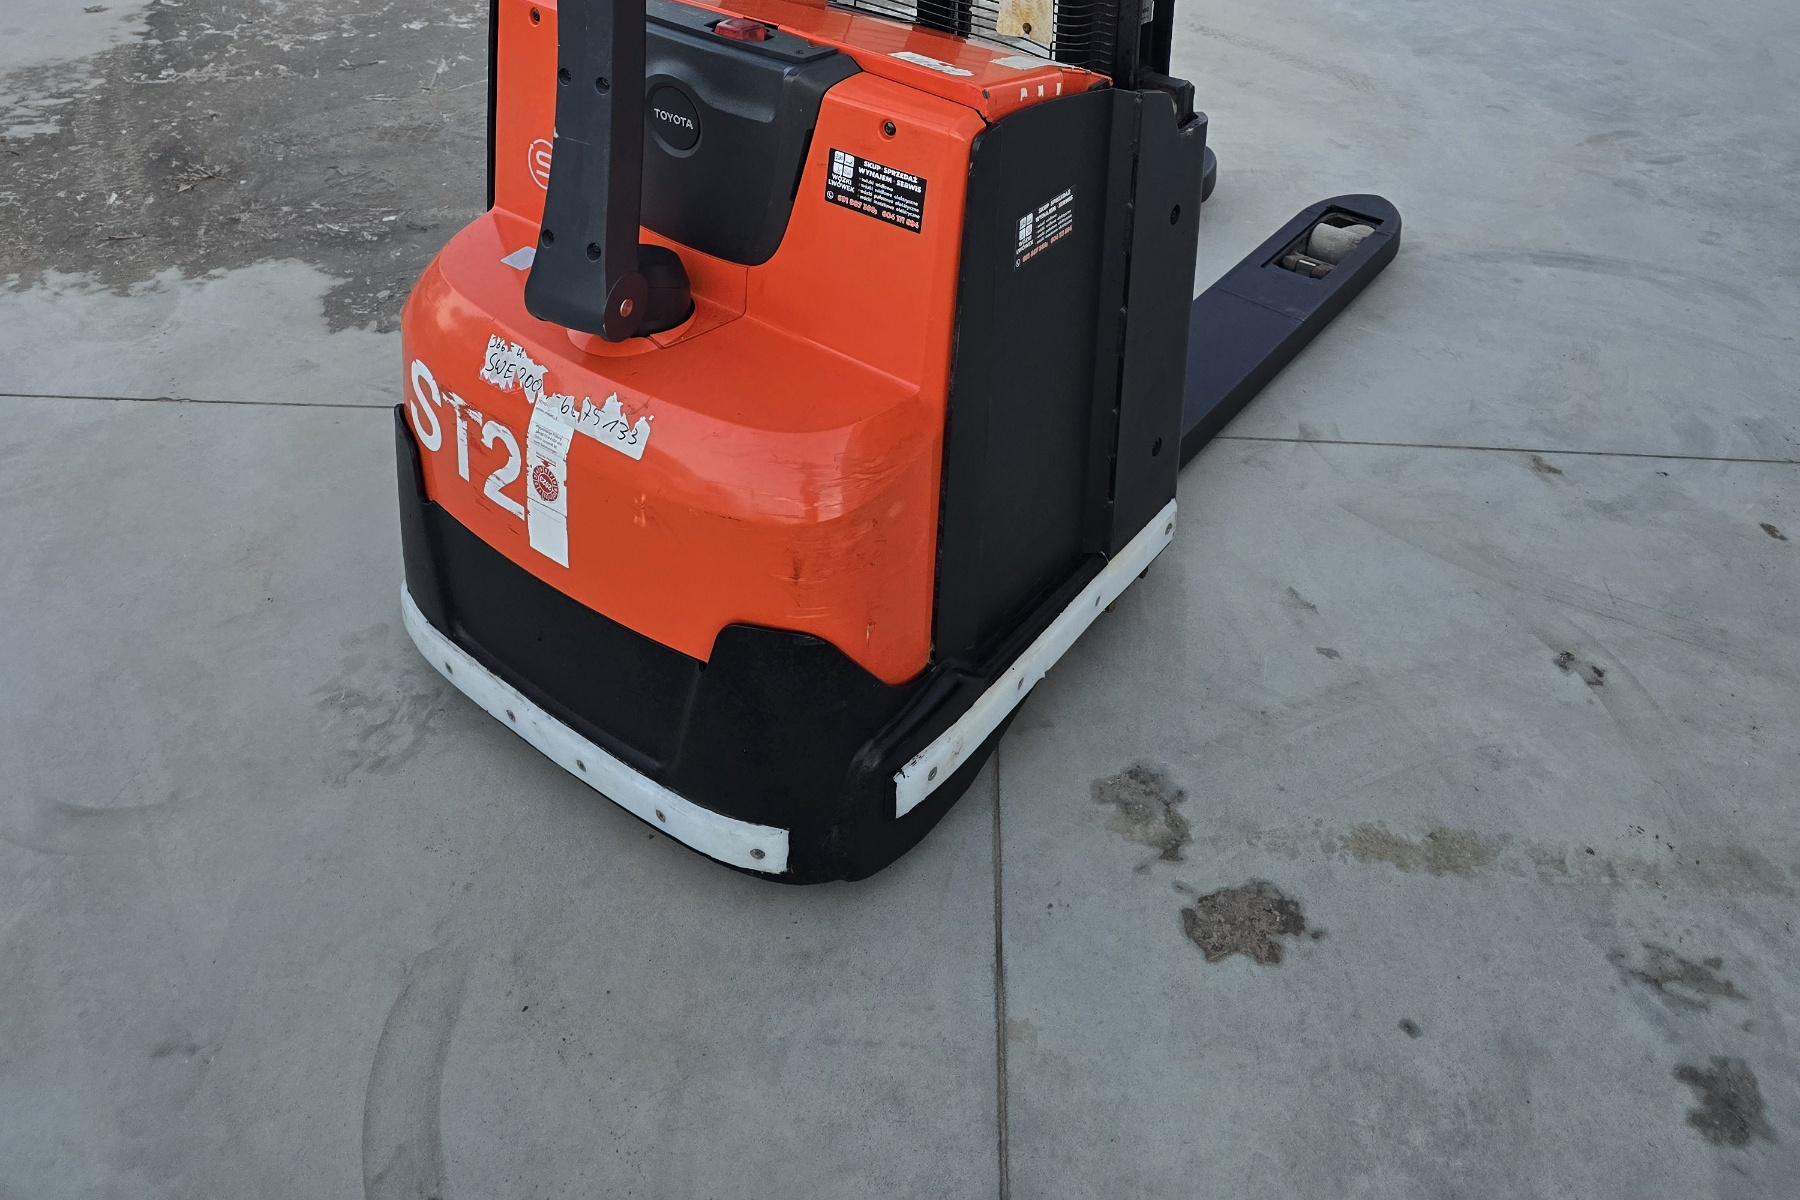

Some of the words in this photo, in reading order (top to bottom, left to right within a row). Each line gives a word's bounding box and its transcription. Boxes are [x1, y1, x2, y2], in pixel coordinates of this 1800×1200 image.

[654, 108, 694, 130] TOYOTA
[832, 172, 852, 186] WÓZKI
[858, 166, 892, 184] WYNAJEM
[896, 180, 922, 194] SERWIS
[864, 161, 881, 171] SKUP
[883, 167, 918, 184] SPRZEDAŻ
[828, 178, 855, 194] LWÓWEK
[411, 358, 525, 521] ST2
